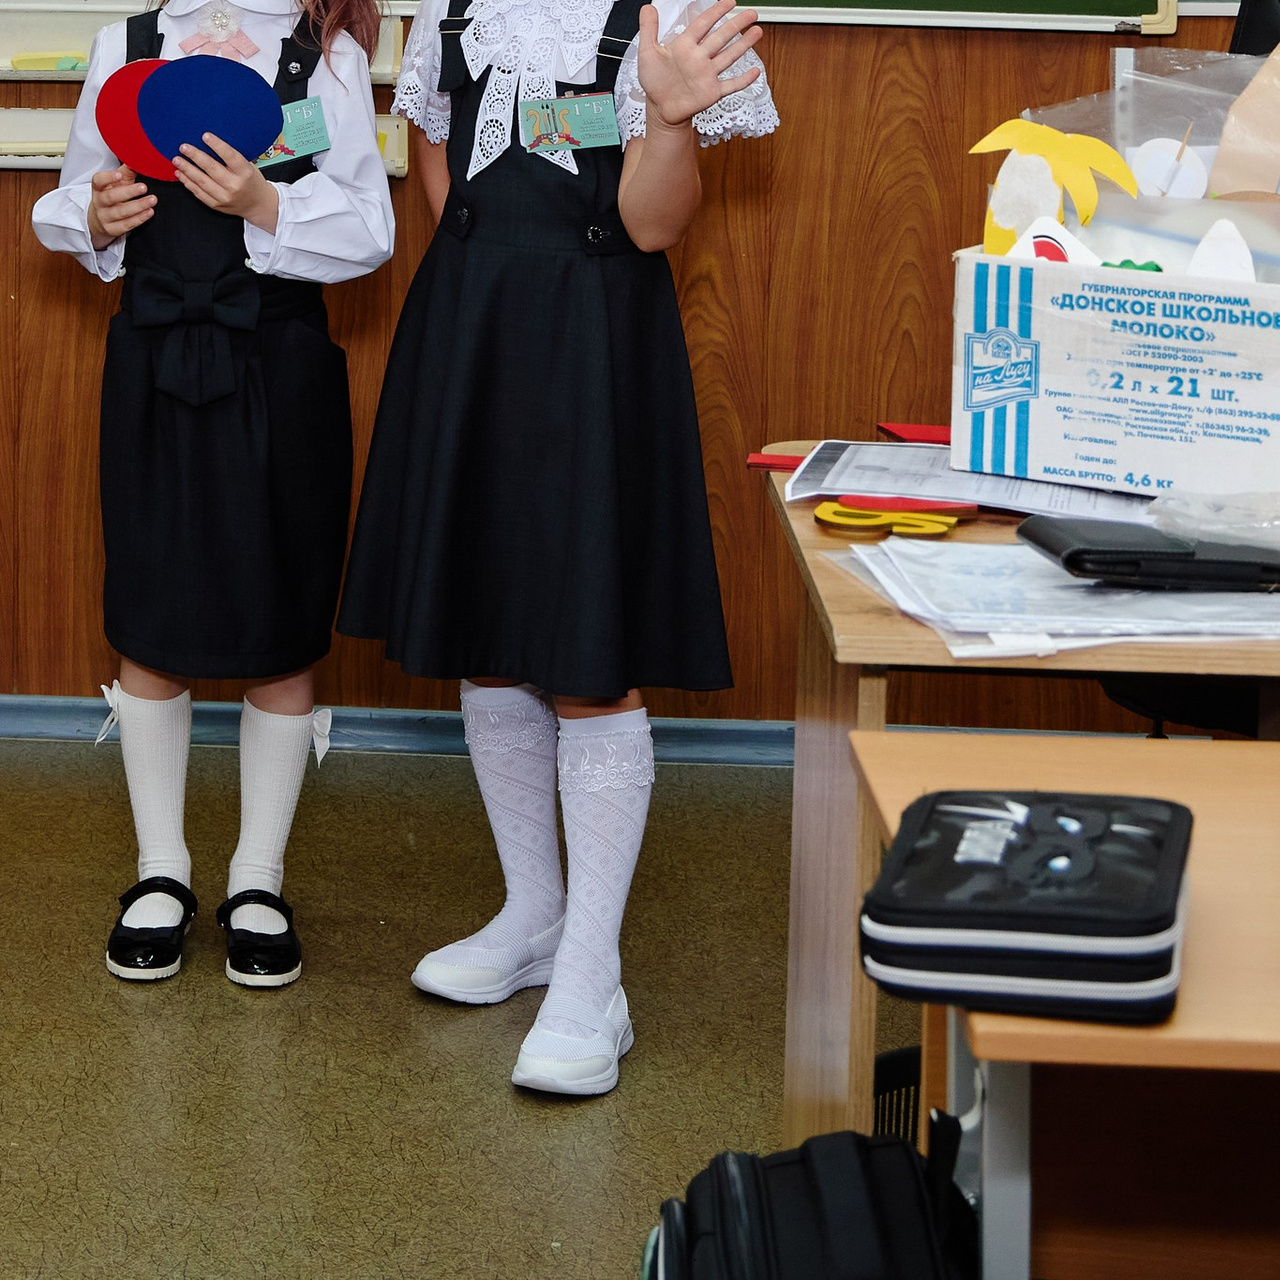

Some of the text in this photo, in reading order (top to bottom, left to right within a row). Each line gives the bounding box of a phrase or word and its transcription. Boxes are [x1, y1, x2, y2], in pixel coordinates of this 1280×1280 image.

[1050, 292, 1156, 317] «ДОНСКОЕ
[1081, 282, 1251, 307] ГУБЕРНАТОРСКАЯ ПРОГРАММА
[1125, 361, 1187, 374] температуре
[1151, 351, 1204, 363] 52090-2003
[1166, 375, 1200, 398] 21
[1043, 466, 1174, 488] МАССА БРУТТО: 4,6 кг
